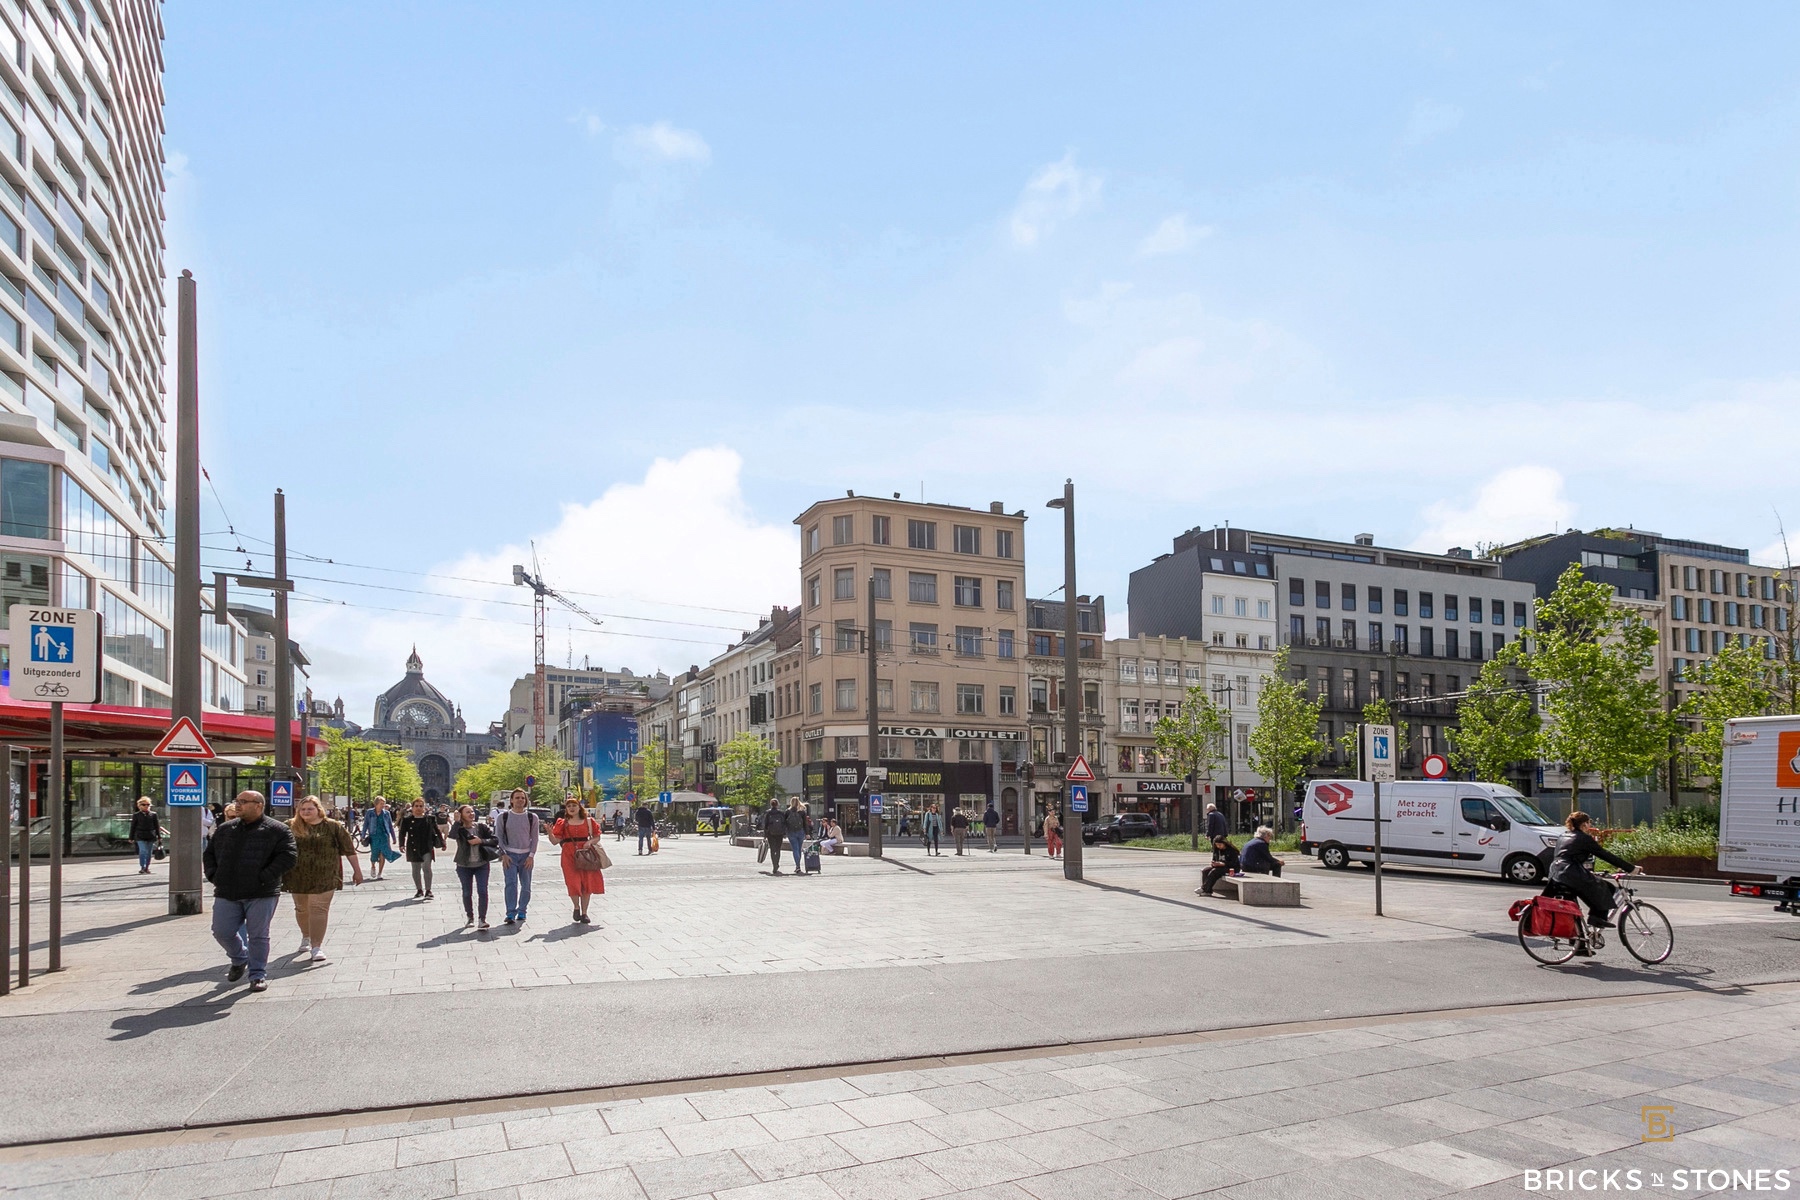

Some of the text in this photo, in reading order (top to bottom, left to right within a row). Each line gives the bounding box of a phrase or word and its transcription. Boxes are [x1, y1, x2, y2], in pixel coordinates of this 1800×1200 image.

[29, 610, 76, 624] ZONE
[23, 667, 81, 678] Uitgezonderd
[805, 729, 822, 738] OUTLET
[878, 727, 1017, 739] MEGA OUTLET
[1372, 727, 1389, 736] ZONE
[839, 775, 855, 783] OUTLET
[889, 772, 908, 785] TOTALE
[1142, 782, 1183, 791] DAMART
[172, 794, 200, 802] TRAM
[1397, 799, 1437, 810] Met zorg
[1396, 809, 1438, 818] gebracht.
